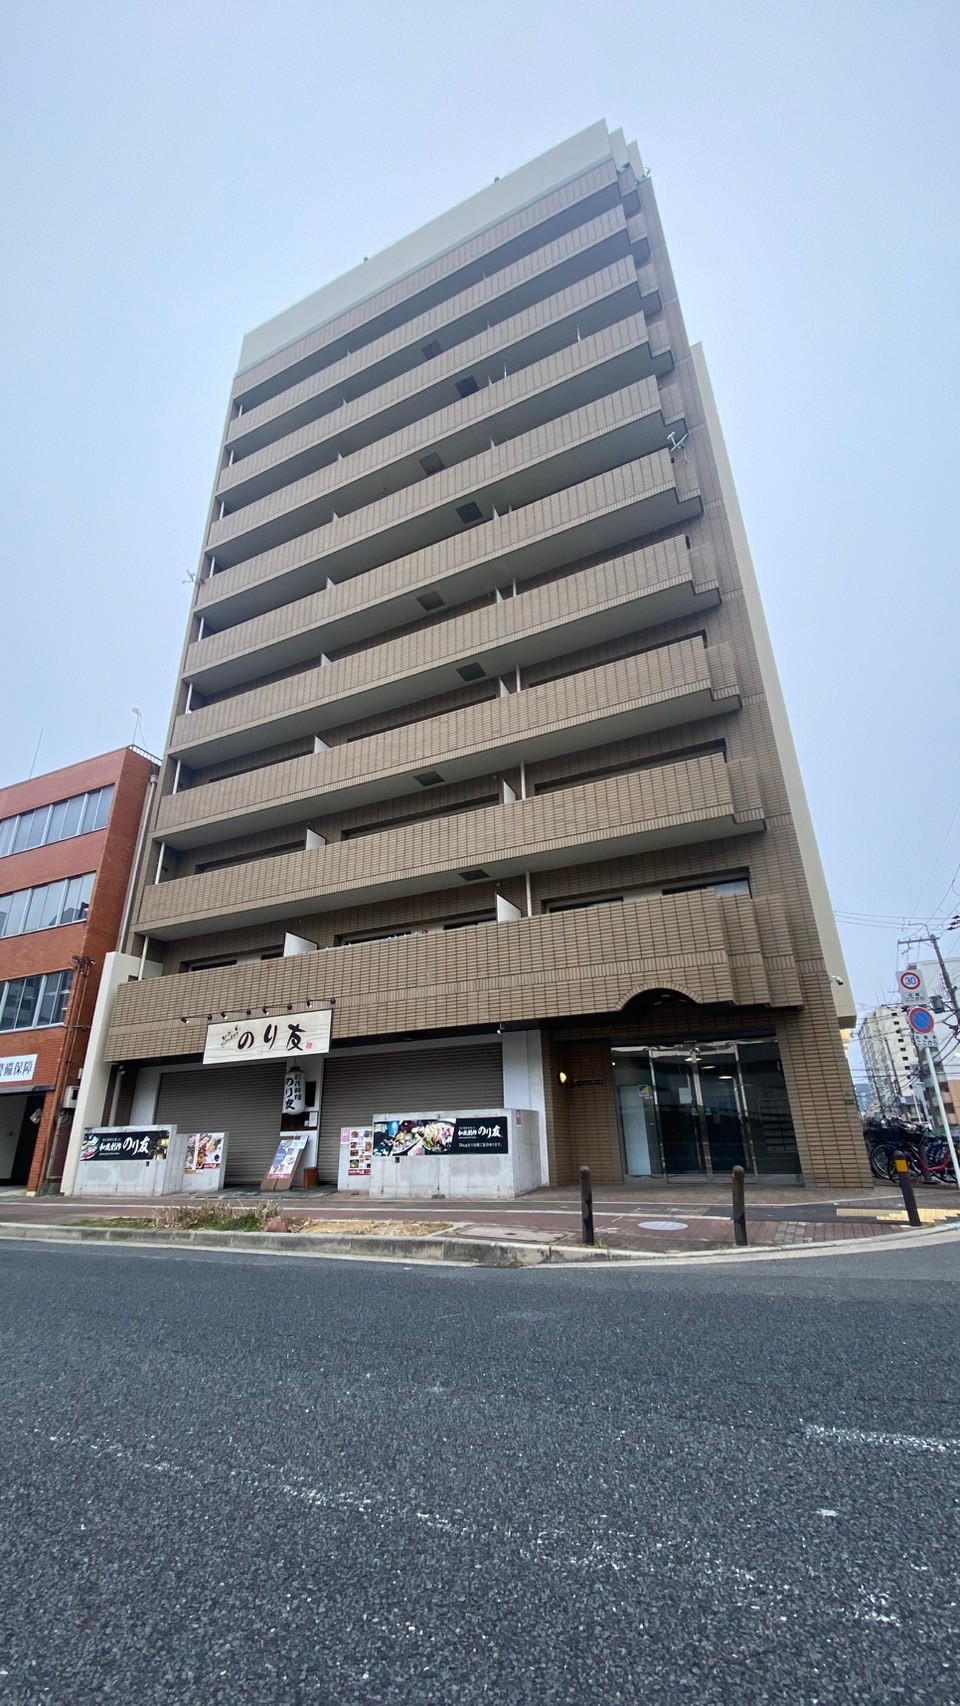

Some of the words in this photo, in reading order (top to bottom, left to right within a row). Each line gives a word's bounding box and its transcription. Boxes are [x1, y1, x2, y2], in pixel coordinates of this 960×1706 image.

[905, 977, 916, 985] 30
[237, 1023, 306, 1051] のり友
[478, 1125, 501, 1138] のり友
[123, 1136, 150, 1155] のり友
